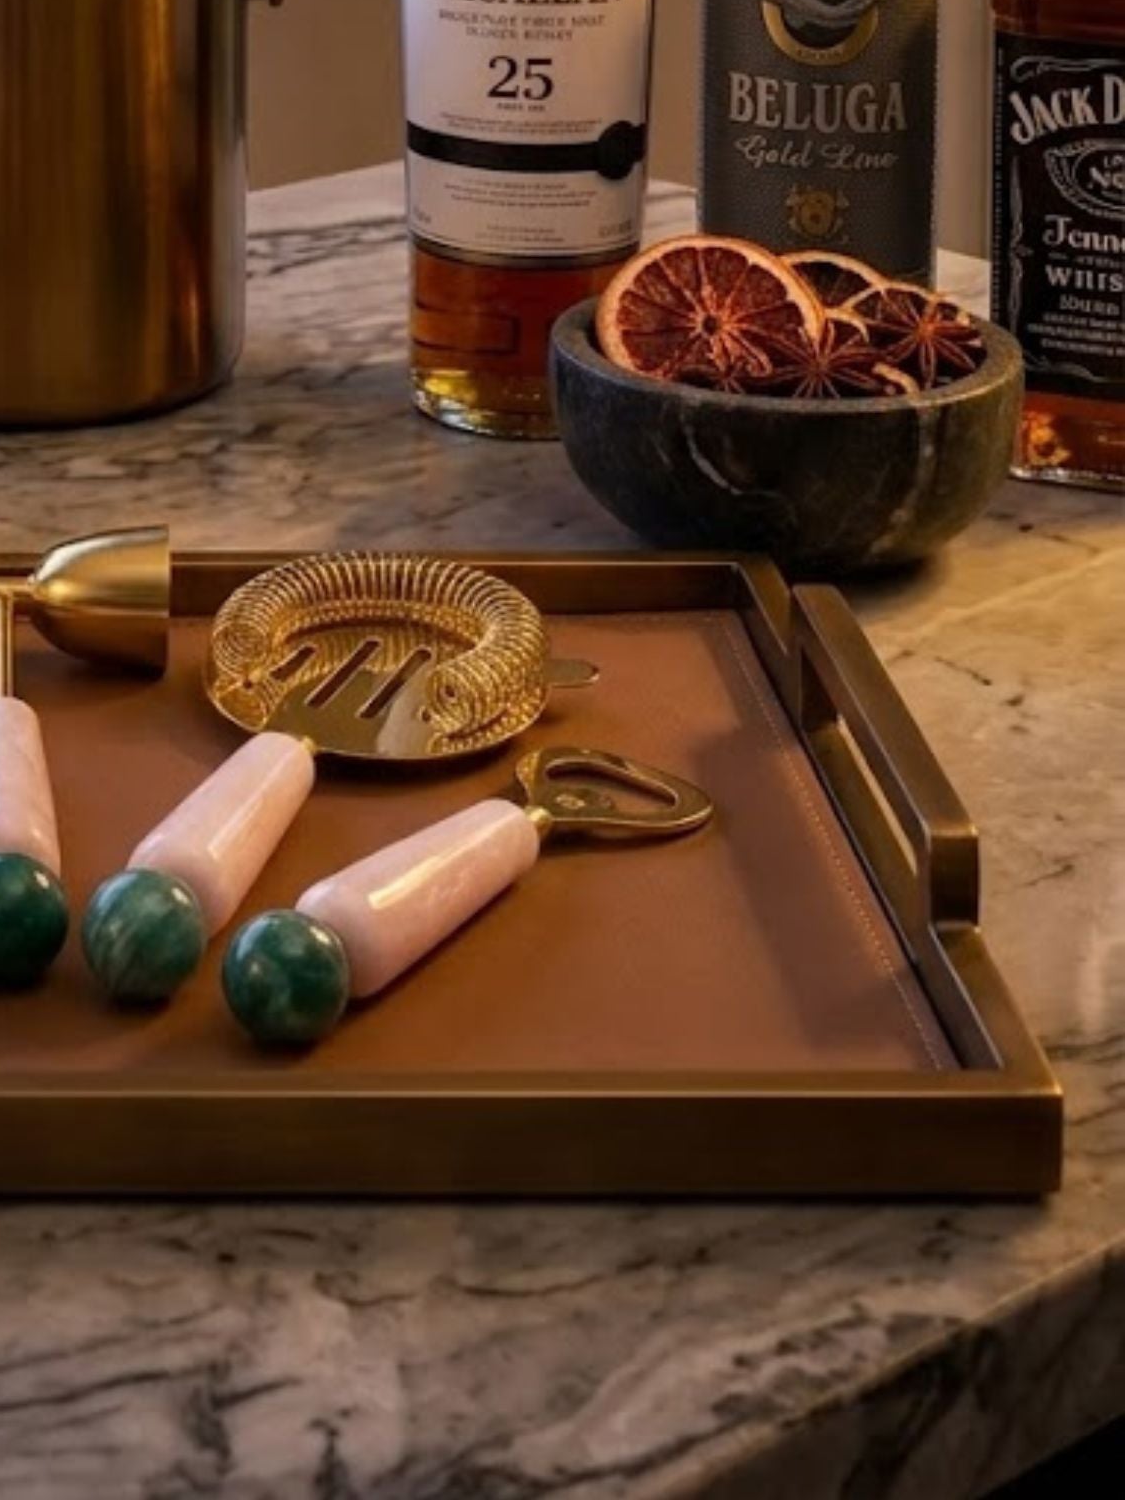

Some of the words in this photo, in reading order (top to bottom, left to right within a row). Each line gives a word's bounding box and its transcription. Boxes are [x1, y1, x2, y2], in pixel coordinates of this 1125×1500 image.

[487, 54, 555, 101] 25
[728, 71, 908, 134] BELUGA
[1009, 85, 1099, 145] JACK
